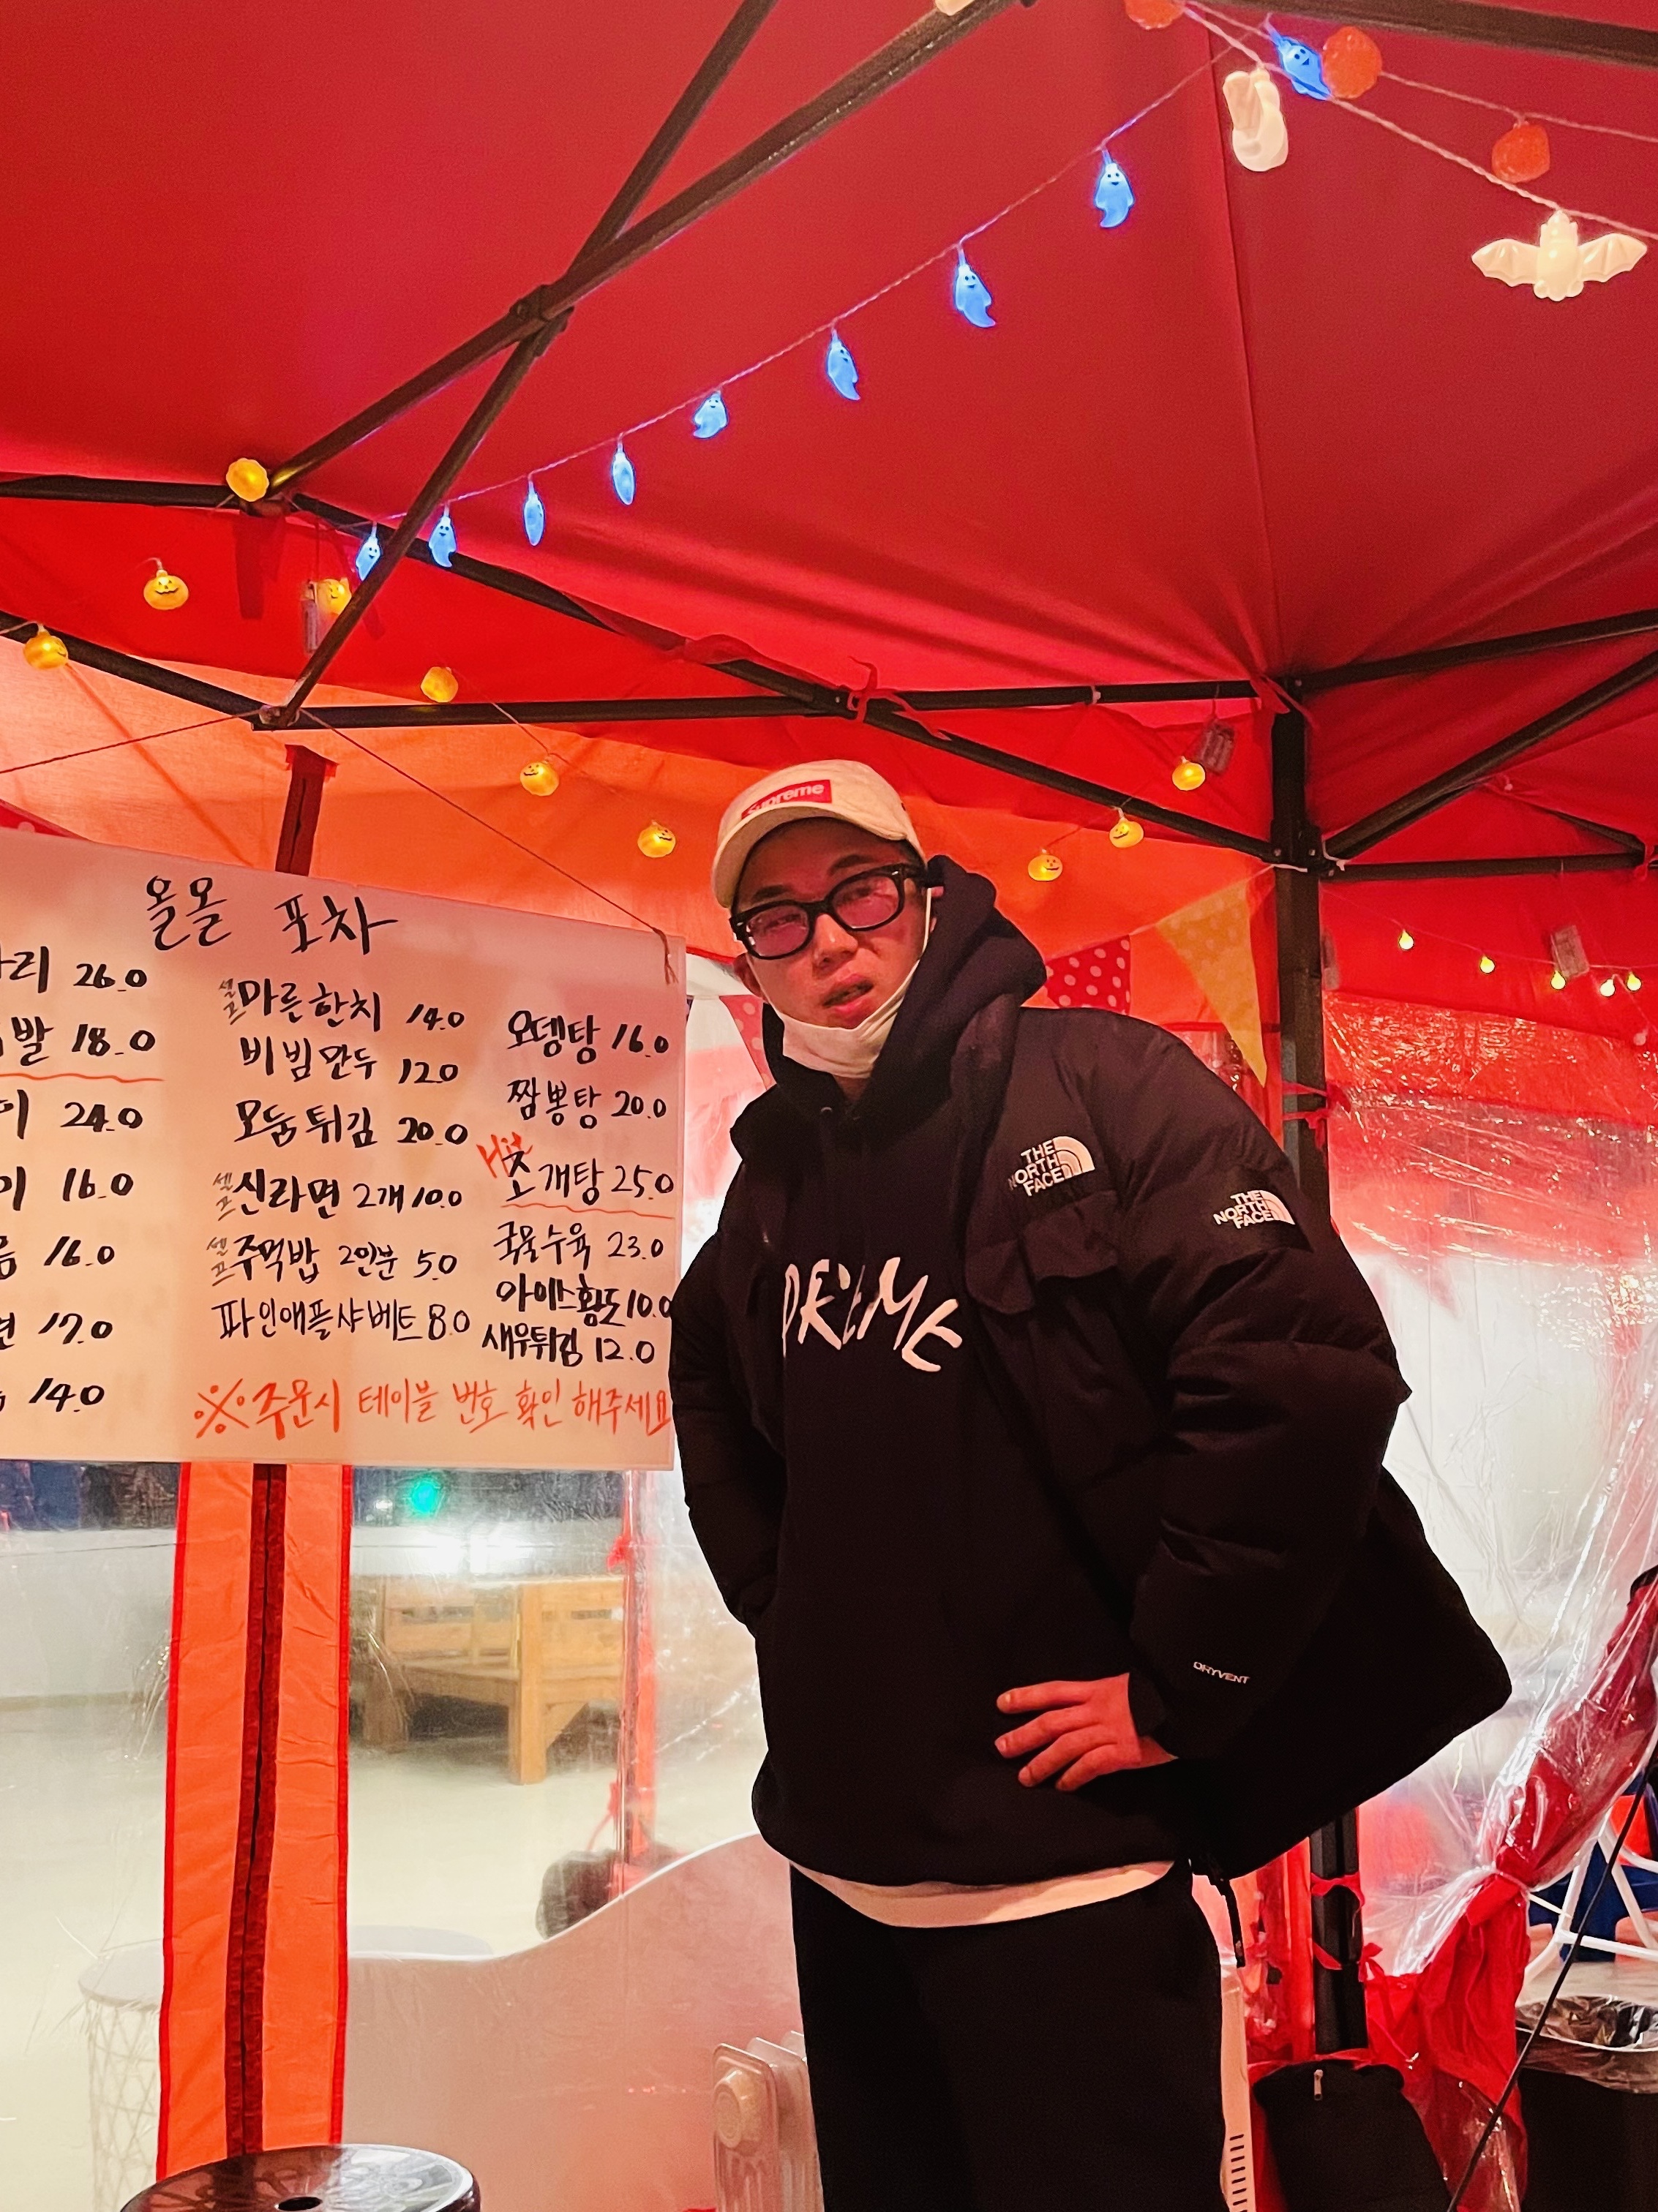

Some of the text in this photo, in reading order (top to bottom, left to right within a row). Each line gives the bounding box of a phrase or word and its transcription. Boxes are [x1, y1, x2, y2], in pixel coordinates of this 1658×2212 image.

[146, 875, 399, 955] 올올 포차
[73, 963, 147, 992] 26.0
[405, 1004, 465, 1031] 14.0
[71, 1023, 156, 1057] 18.0
[507, 1010, 669, 1065] 오뎅탕 16.0
[60, 1102, 143, 1132] 24.0
[507, 1077, 667, 1129] 짬뽕탕 20.0
[397, 1117, 468, 1146] 20.0
[1020, 1140, 1055, 1164] THE
[62, 1167, 134, 1202] 16.0
[500, 1150, 674, 1205] 조개탕 25.0
[1008, 1153, 1061, 1191] NORTH
[1022, 1167, 1065, 1196] FACE
[232, 1168, 462, 1219] 신라면 2개 10.0
[1230, 1190, 1263, 1205] THE
[1213, 1200, 1269, 1224] NORTH
[1233, 1210, 1274, 1229] FACE
[43, 1235, 115, 1267] 16.0
[226, 1234, 457, 1284] 주먹밥 2인분 5.0
[607, 1231, 664, 1260] 23.0
[481, 1323, 655, 1367] 새우튀김 12.0
[359, 1378, 439, 1424] 테이블
[452, 1380, 509, 1434] 번호
[515, 1378, 563, 1432] 확인
